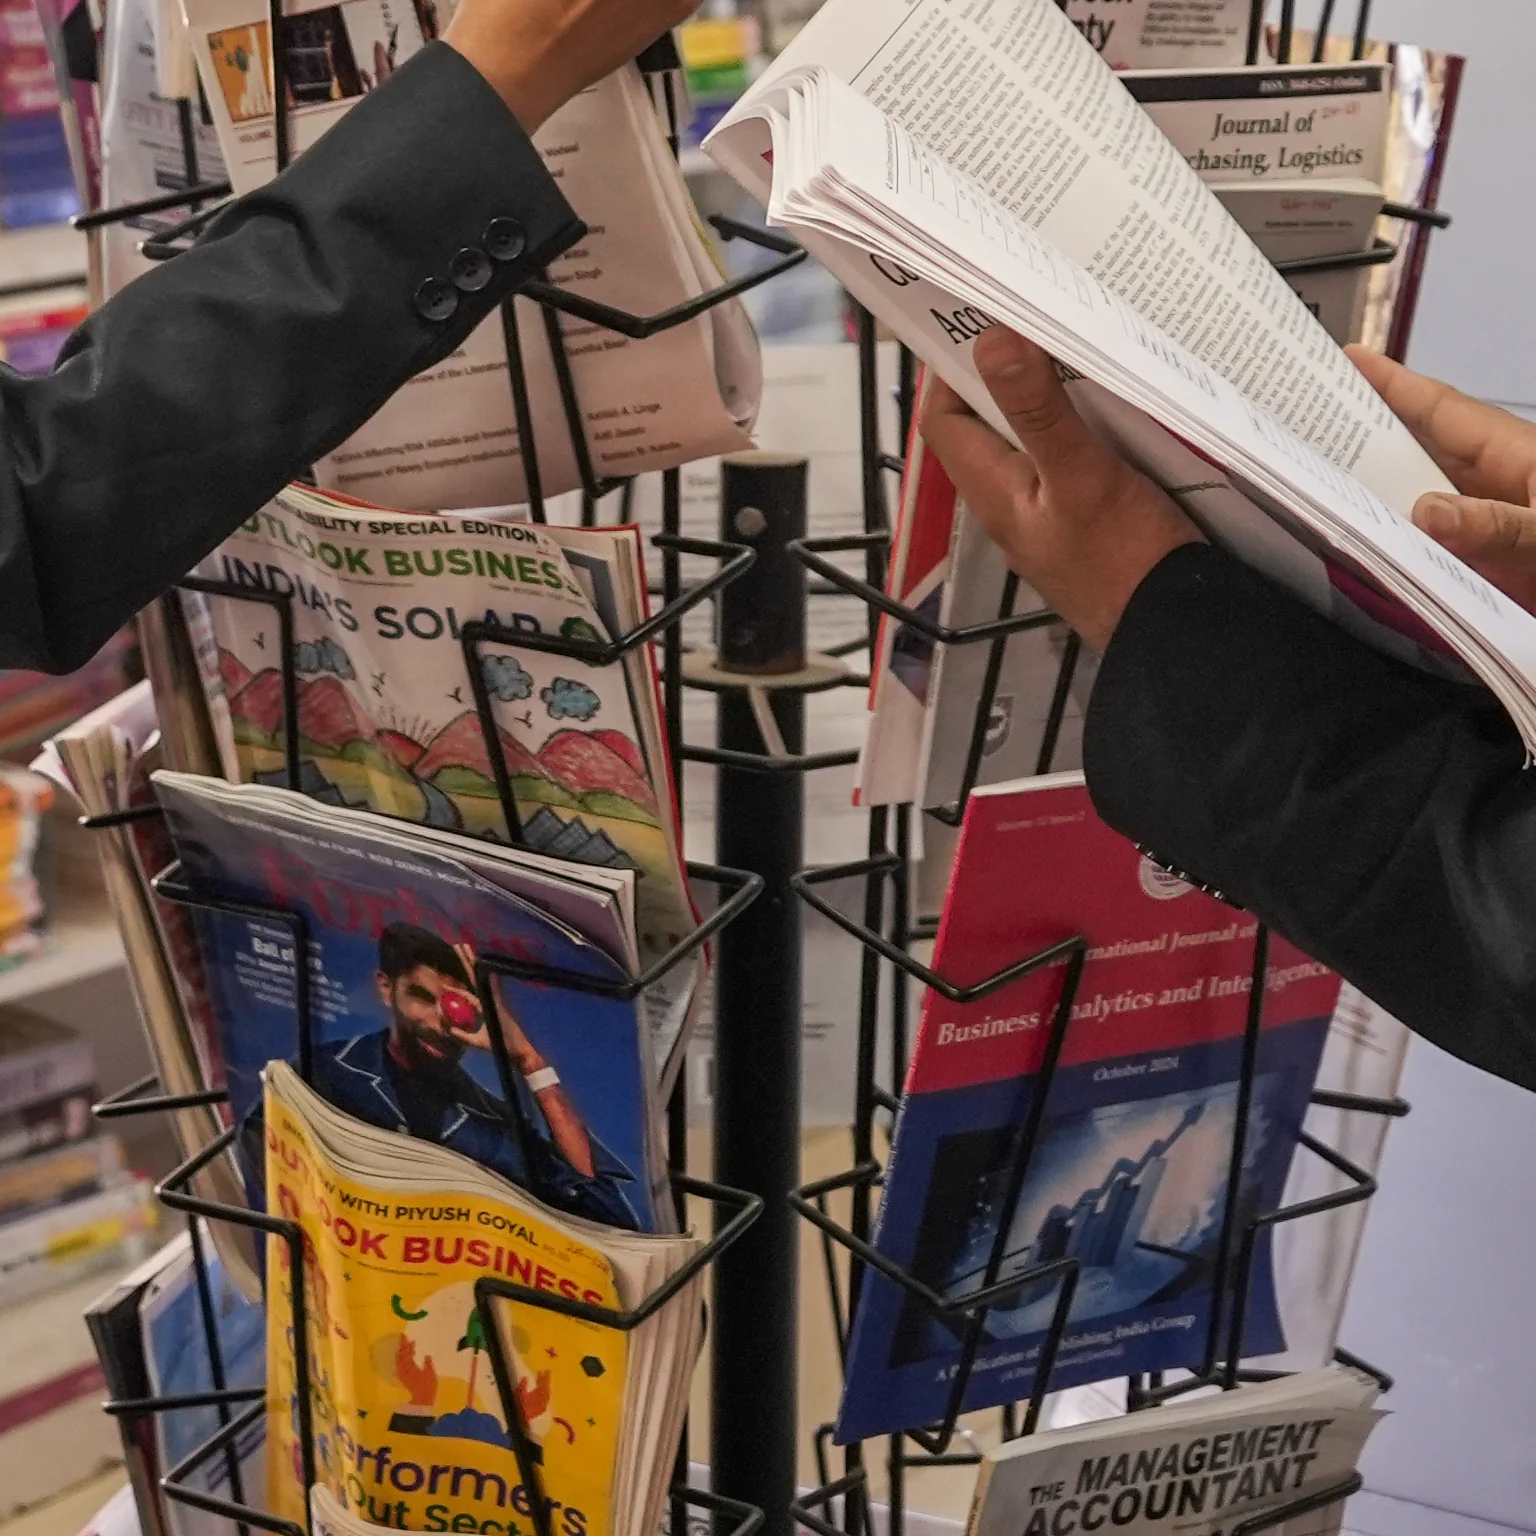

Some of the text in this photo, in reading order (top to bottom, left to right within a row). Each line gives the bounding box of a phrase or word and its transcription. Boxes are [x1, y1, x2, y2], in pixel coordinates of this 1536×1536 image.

[1211, 109, 1317, 141] Journal of
[1279, 145, 1363, 174] Logistics
[240, 512, 372, 576] UTLOOK
[369, 520, 537, 544] SPECIAL EDITION
[222, 553, 360, 632] INDIA'S
[252, 935, 280, 956] Ball
[1169, 924, 1231, 951] Journal
[1237, 921, 1258, 939] of
[936, 1009, 1040, 1046] Business
[1159, 981, 1203, 1006] and
[1093, 1063, 1142, 1082] October
[336, 1192, 538, 1247] WITH PIYUSH GOYAL
[403, 1235, 605, 1307] BUSINESS
[1029, 1418, 1334, 1507] THE MANAGEMENT
[1025, 1451, 1319, 1536] ACCOUNTANT
